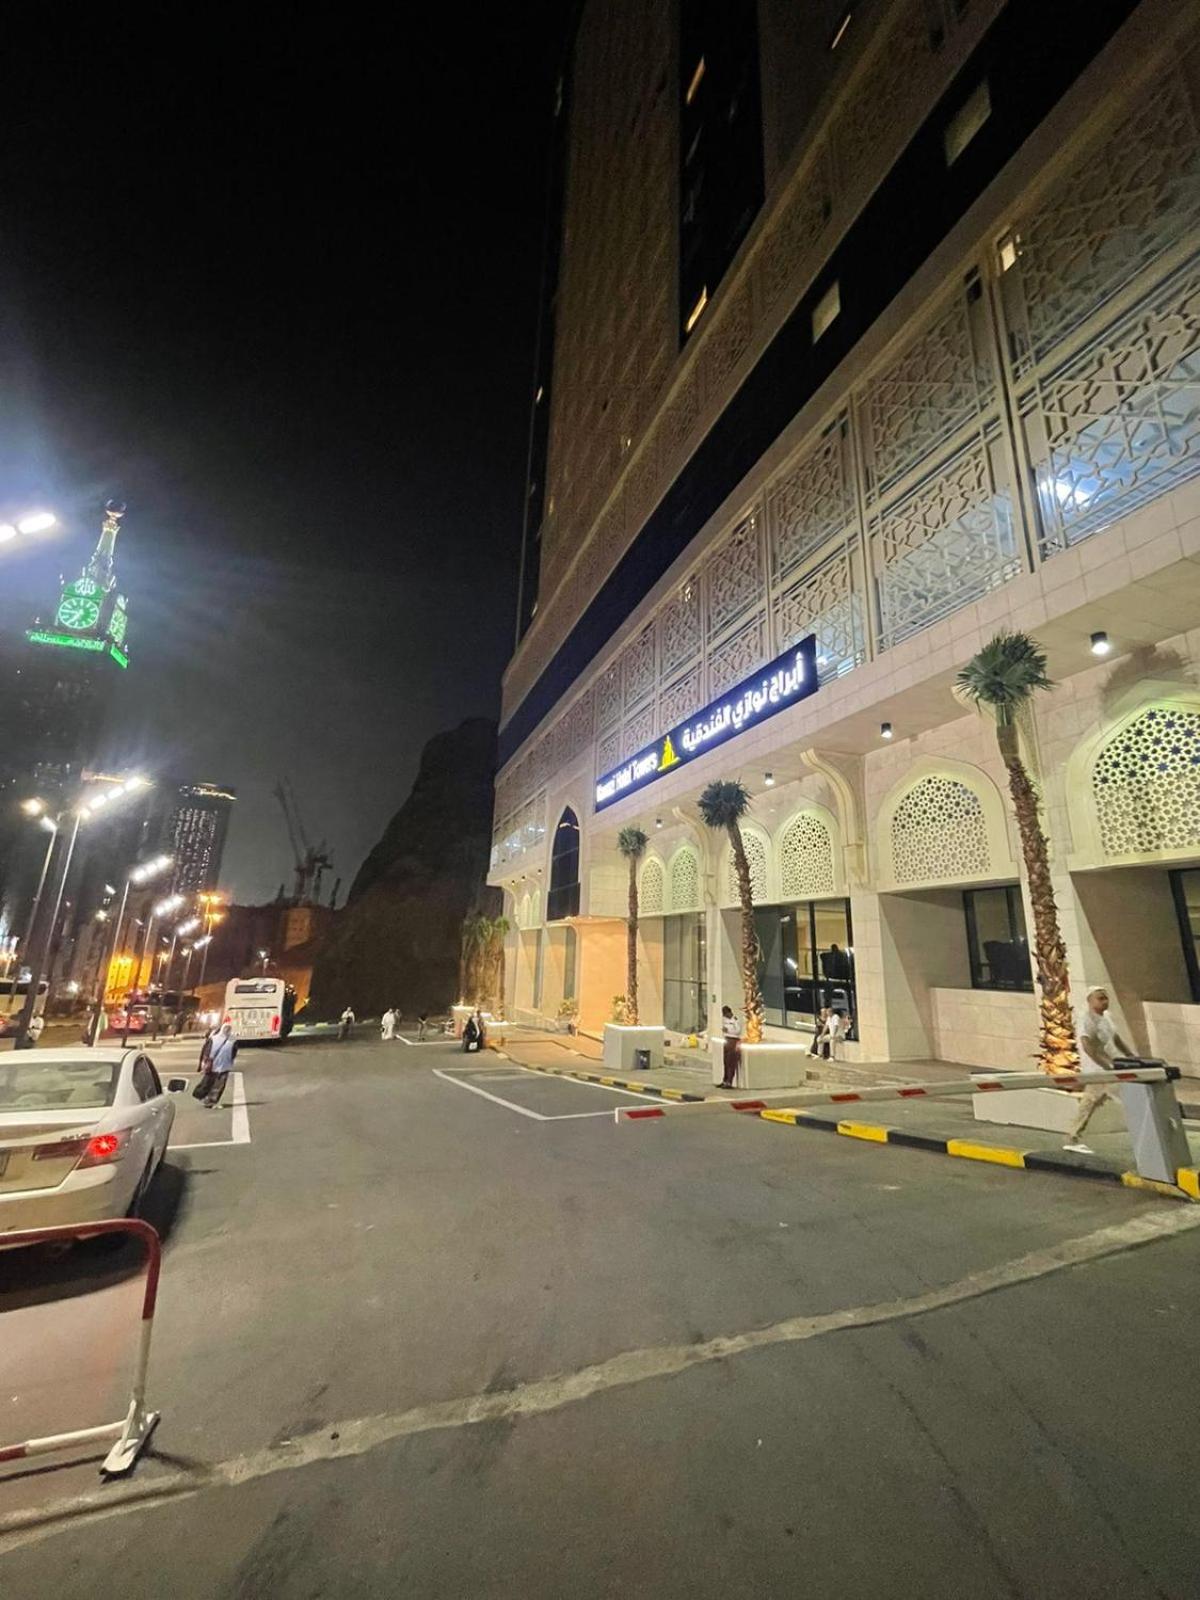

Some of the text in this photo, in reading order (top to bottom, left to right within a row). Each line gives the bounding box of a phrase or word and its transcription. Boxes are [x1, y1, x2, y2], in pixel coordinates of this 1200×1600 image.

[682, 651, 804, 752] أبراج نوازي الفندقية
